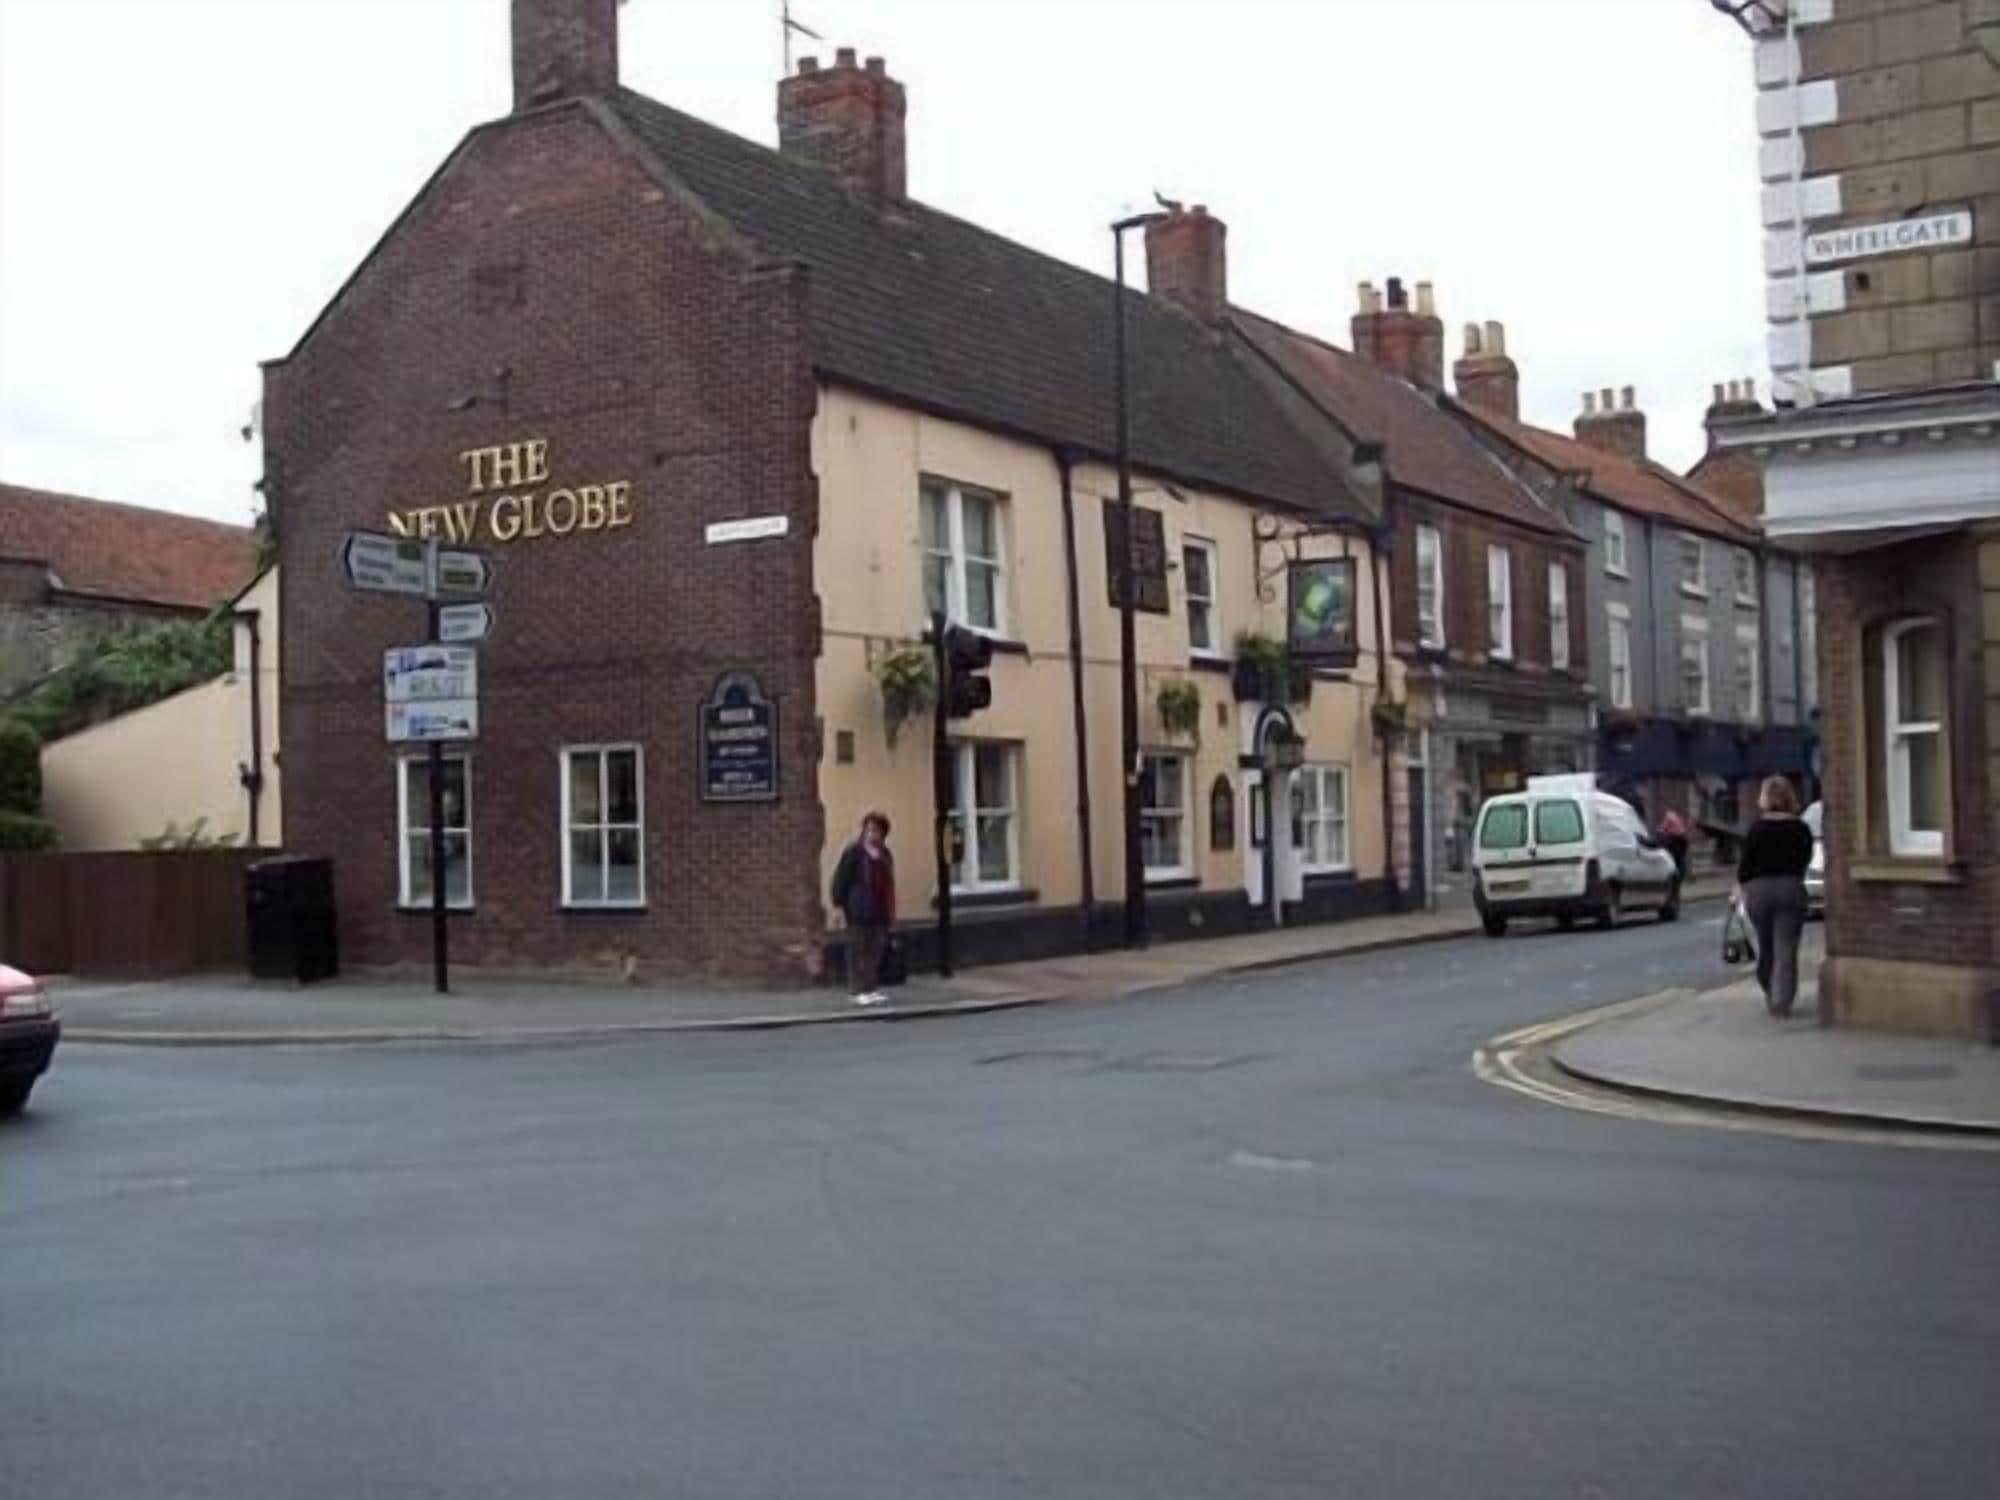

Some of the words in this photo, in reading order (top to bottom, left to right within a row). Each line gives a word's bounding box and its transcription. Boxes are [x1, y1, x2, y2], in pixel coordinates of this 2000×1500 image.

[460, 439, 549, 492] THE
[388, 503, 478, 544] NEW
[490, 480, 633, 540] GLOBE
